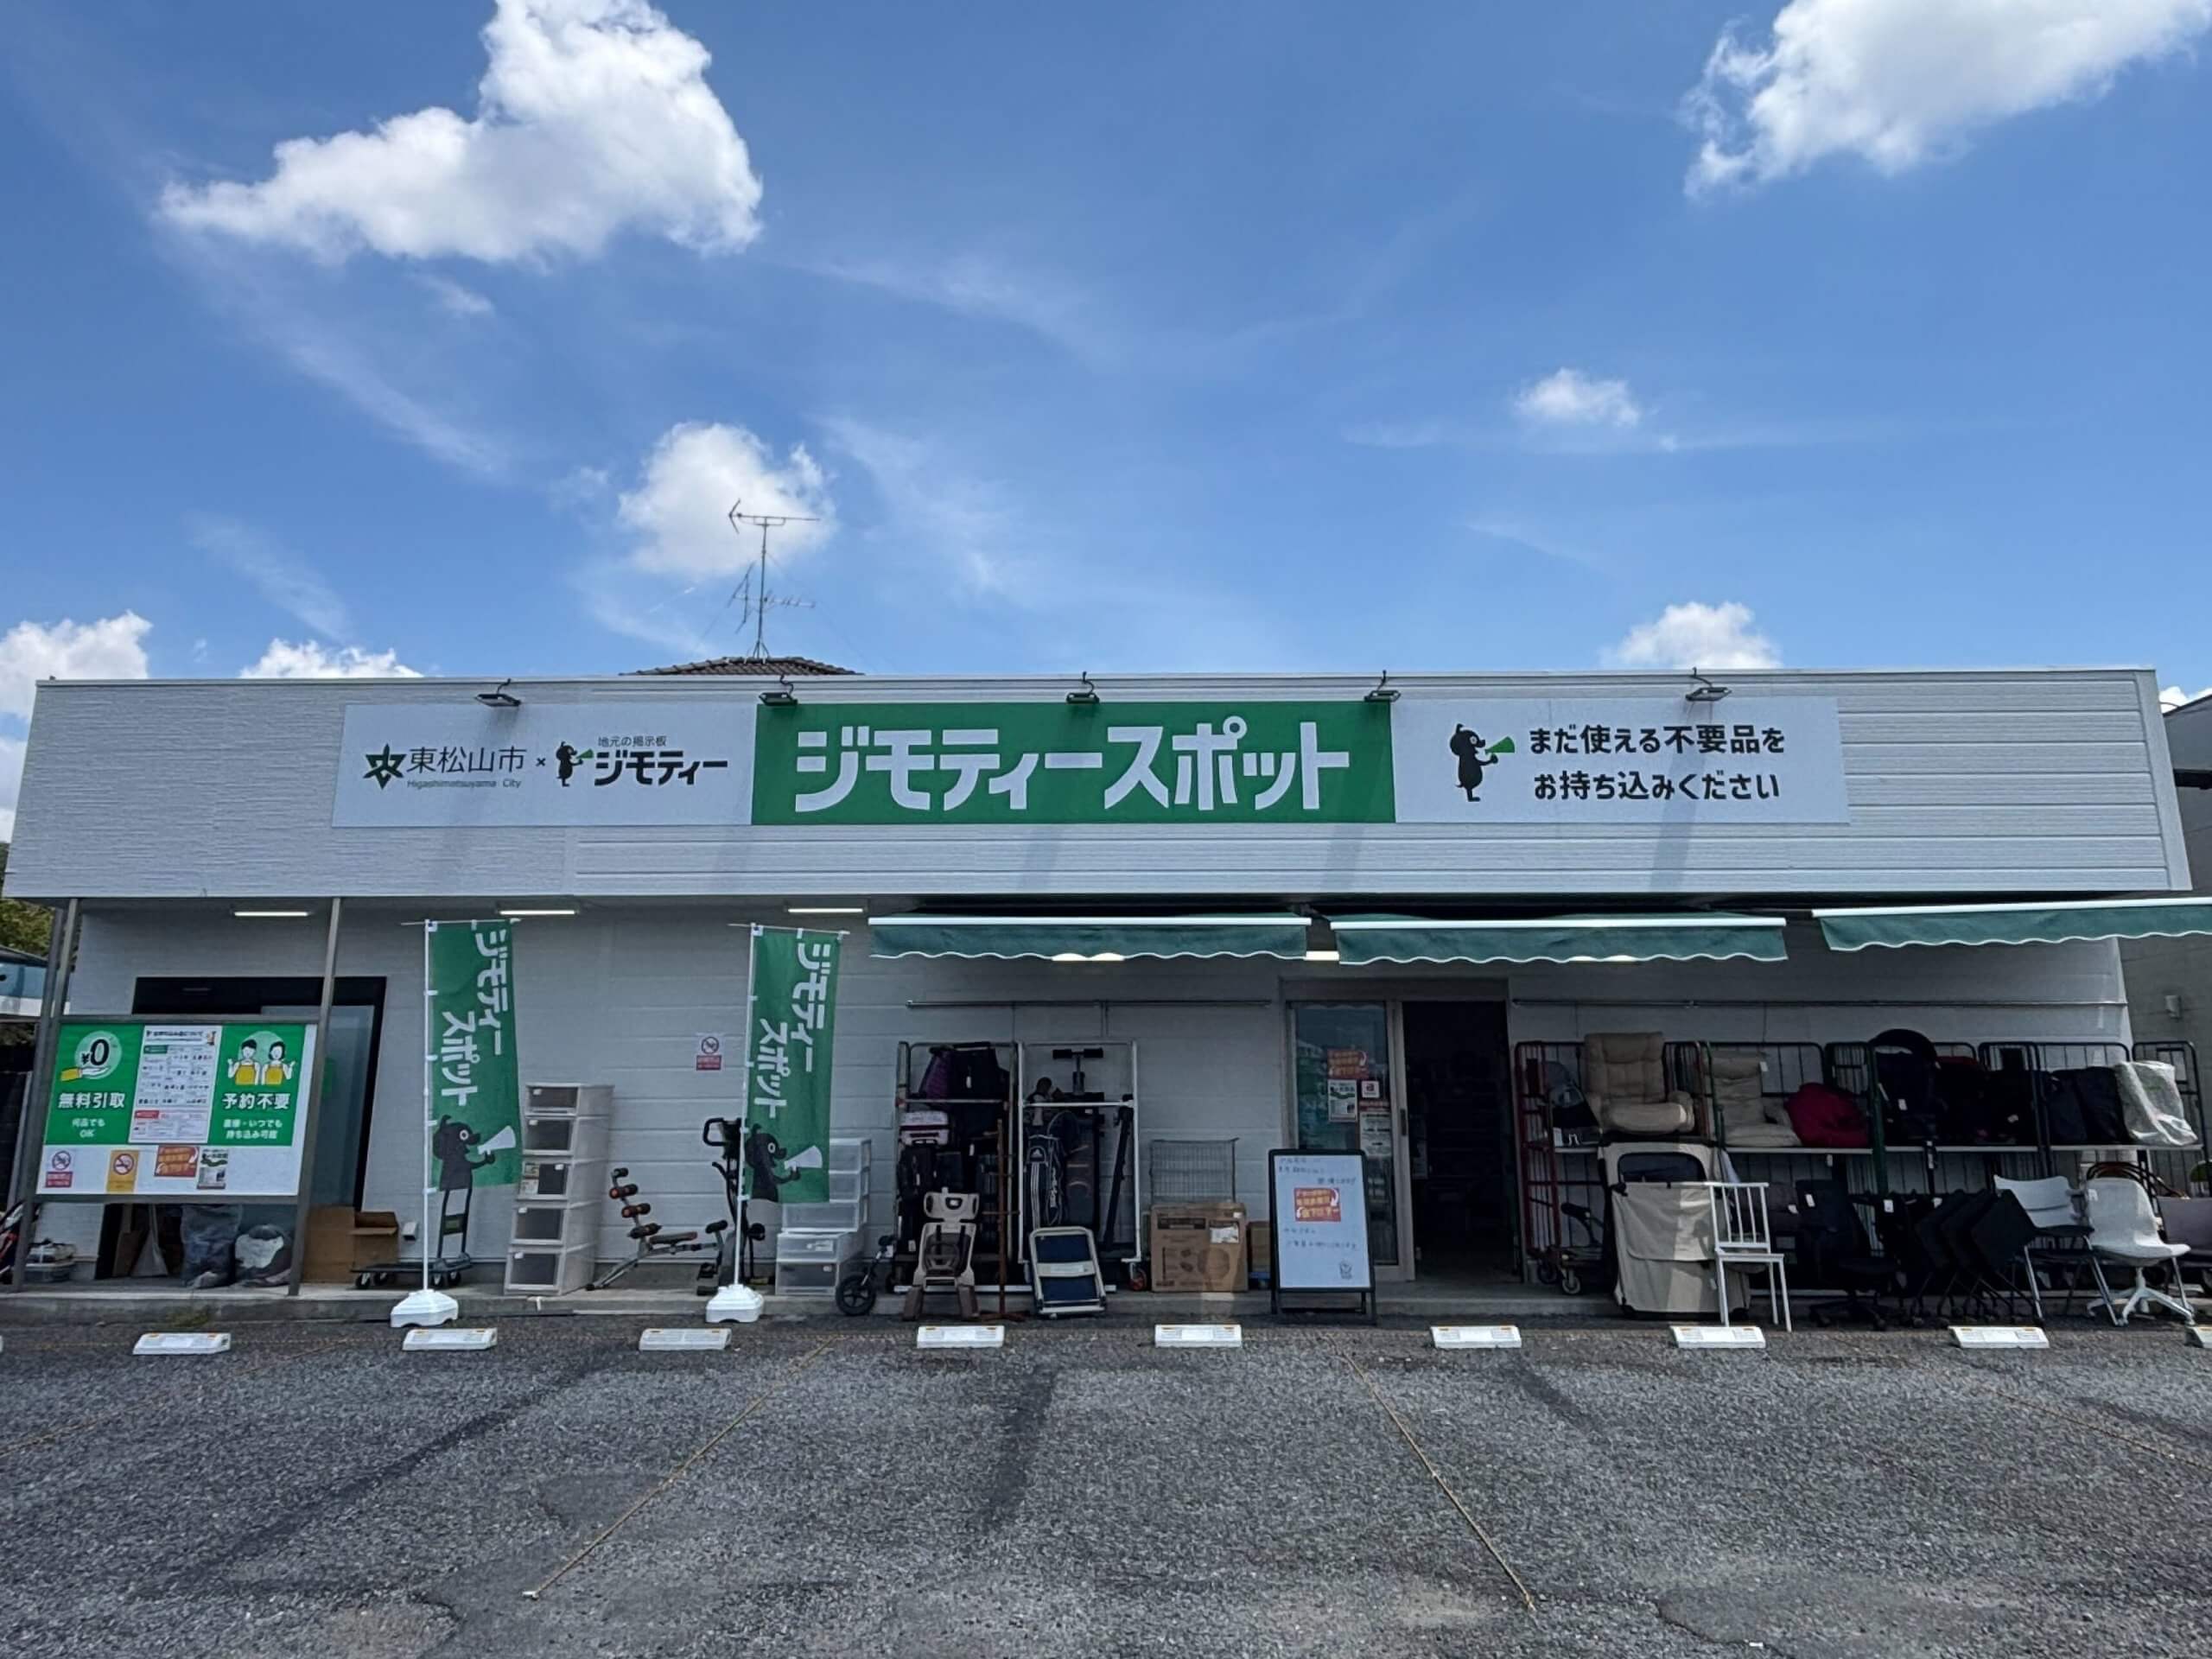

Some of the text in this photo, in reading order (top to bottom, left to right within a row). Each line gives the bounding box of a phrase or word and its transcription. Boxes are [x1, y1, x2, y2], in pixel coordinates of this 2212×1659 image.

[598, 736, 667, 747] 地元の掲示板
[1529, 723, 1785, 755] まだ使える不要品を
[406, 746, 527, 774] 東松山市
[594, 749, 728, 786] ジモティー
[795, 715, 1350, 813] ジモティースポット
[407, 779, 522, 790] Higashimatsuyama City
[1534, 770, 1780, 801] お持ち込みください
[475, 929, 508, 1055] ジモティー
[791, 943, 831, 1071] ジモティー
[441, 1010, 480, 1107] スポット
[754, 1018, 791, 1118] スポット
[58, 1092, 125, 1109] 無料引取
[222, 1093, 291, 1109] 予約不要
[79, 1128, 96, 1138] OK
